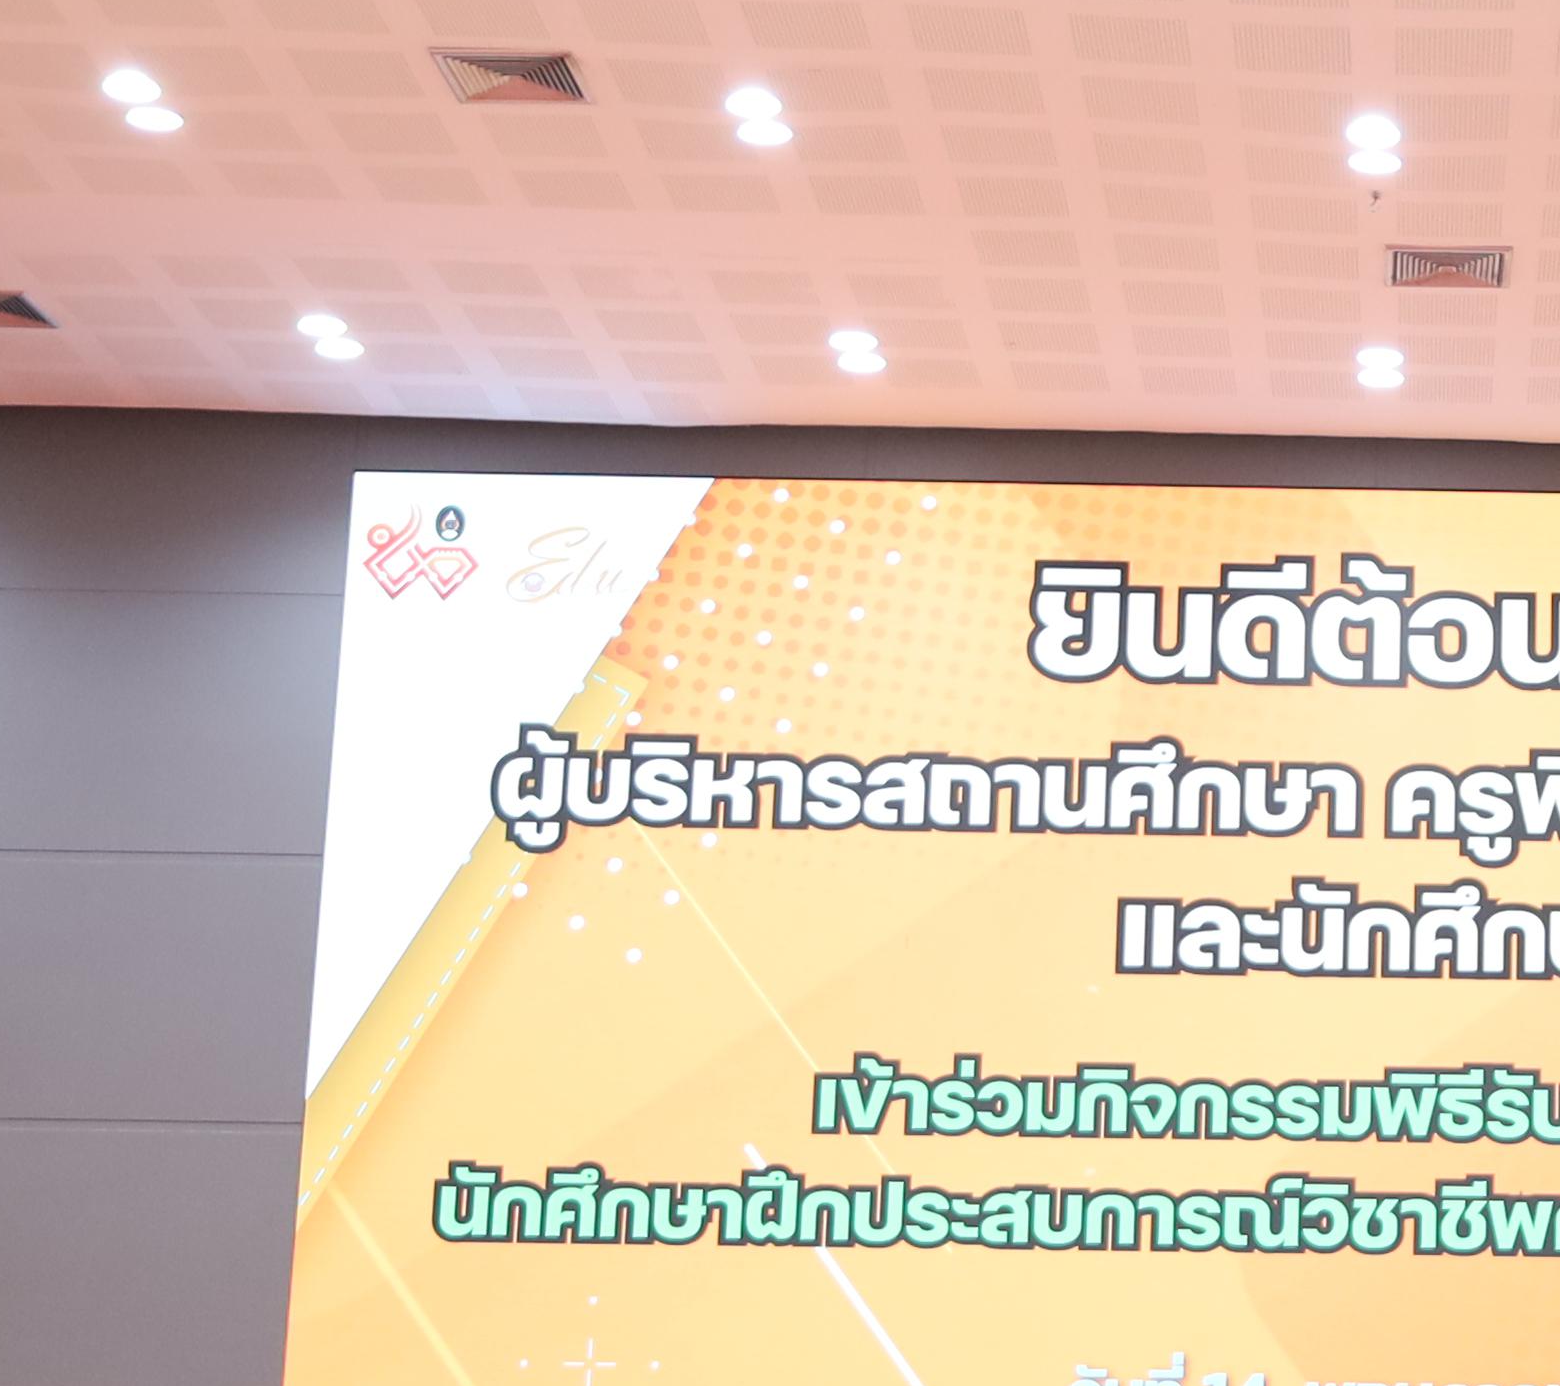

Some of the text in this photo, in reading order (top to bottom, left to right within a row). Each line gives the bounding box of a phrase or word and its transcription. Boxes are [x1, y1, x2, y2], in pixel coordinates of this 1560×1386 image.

[492, 723, 1364, 853] ผู้บริหารสถานศึกษา
